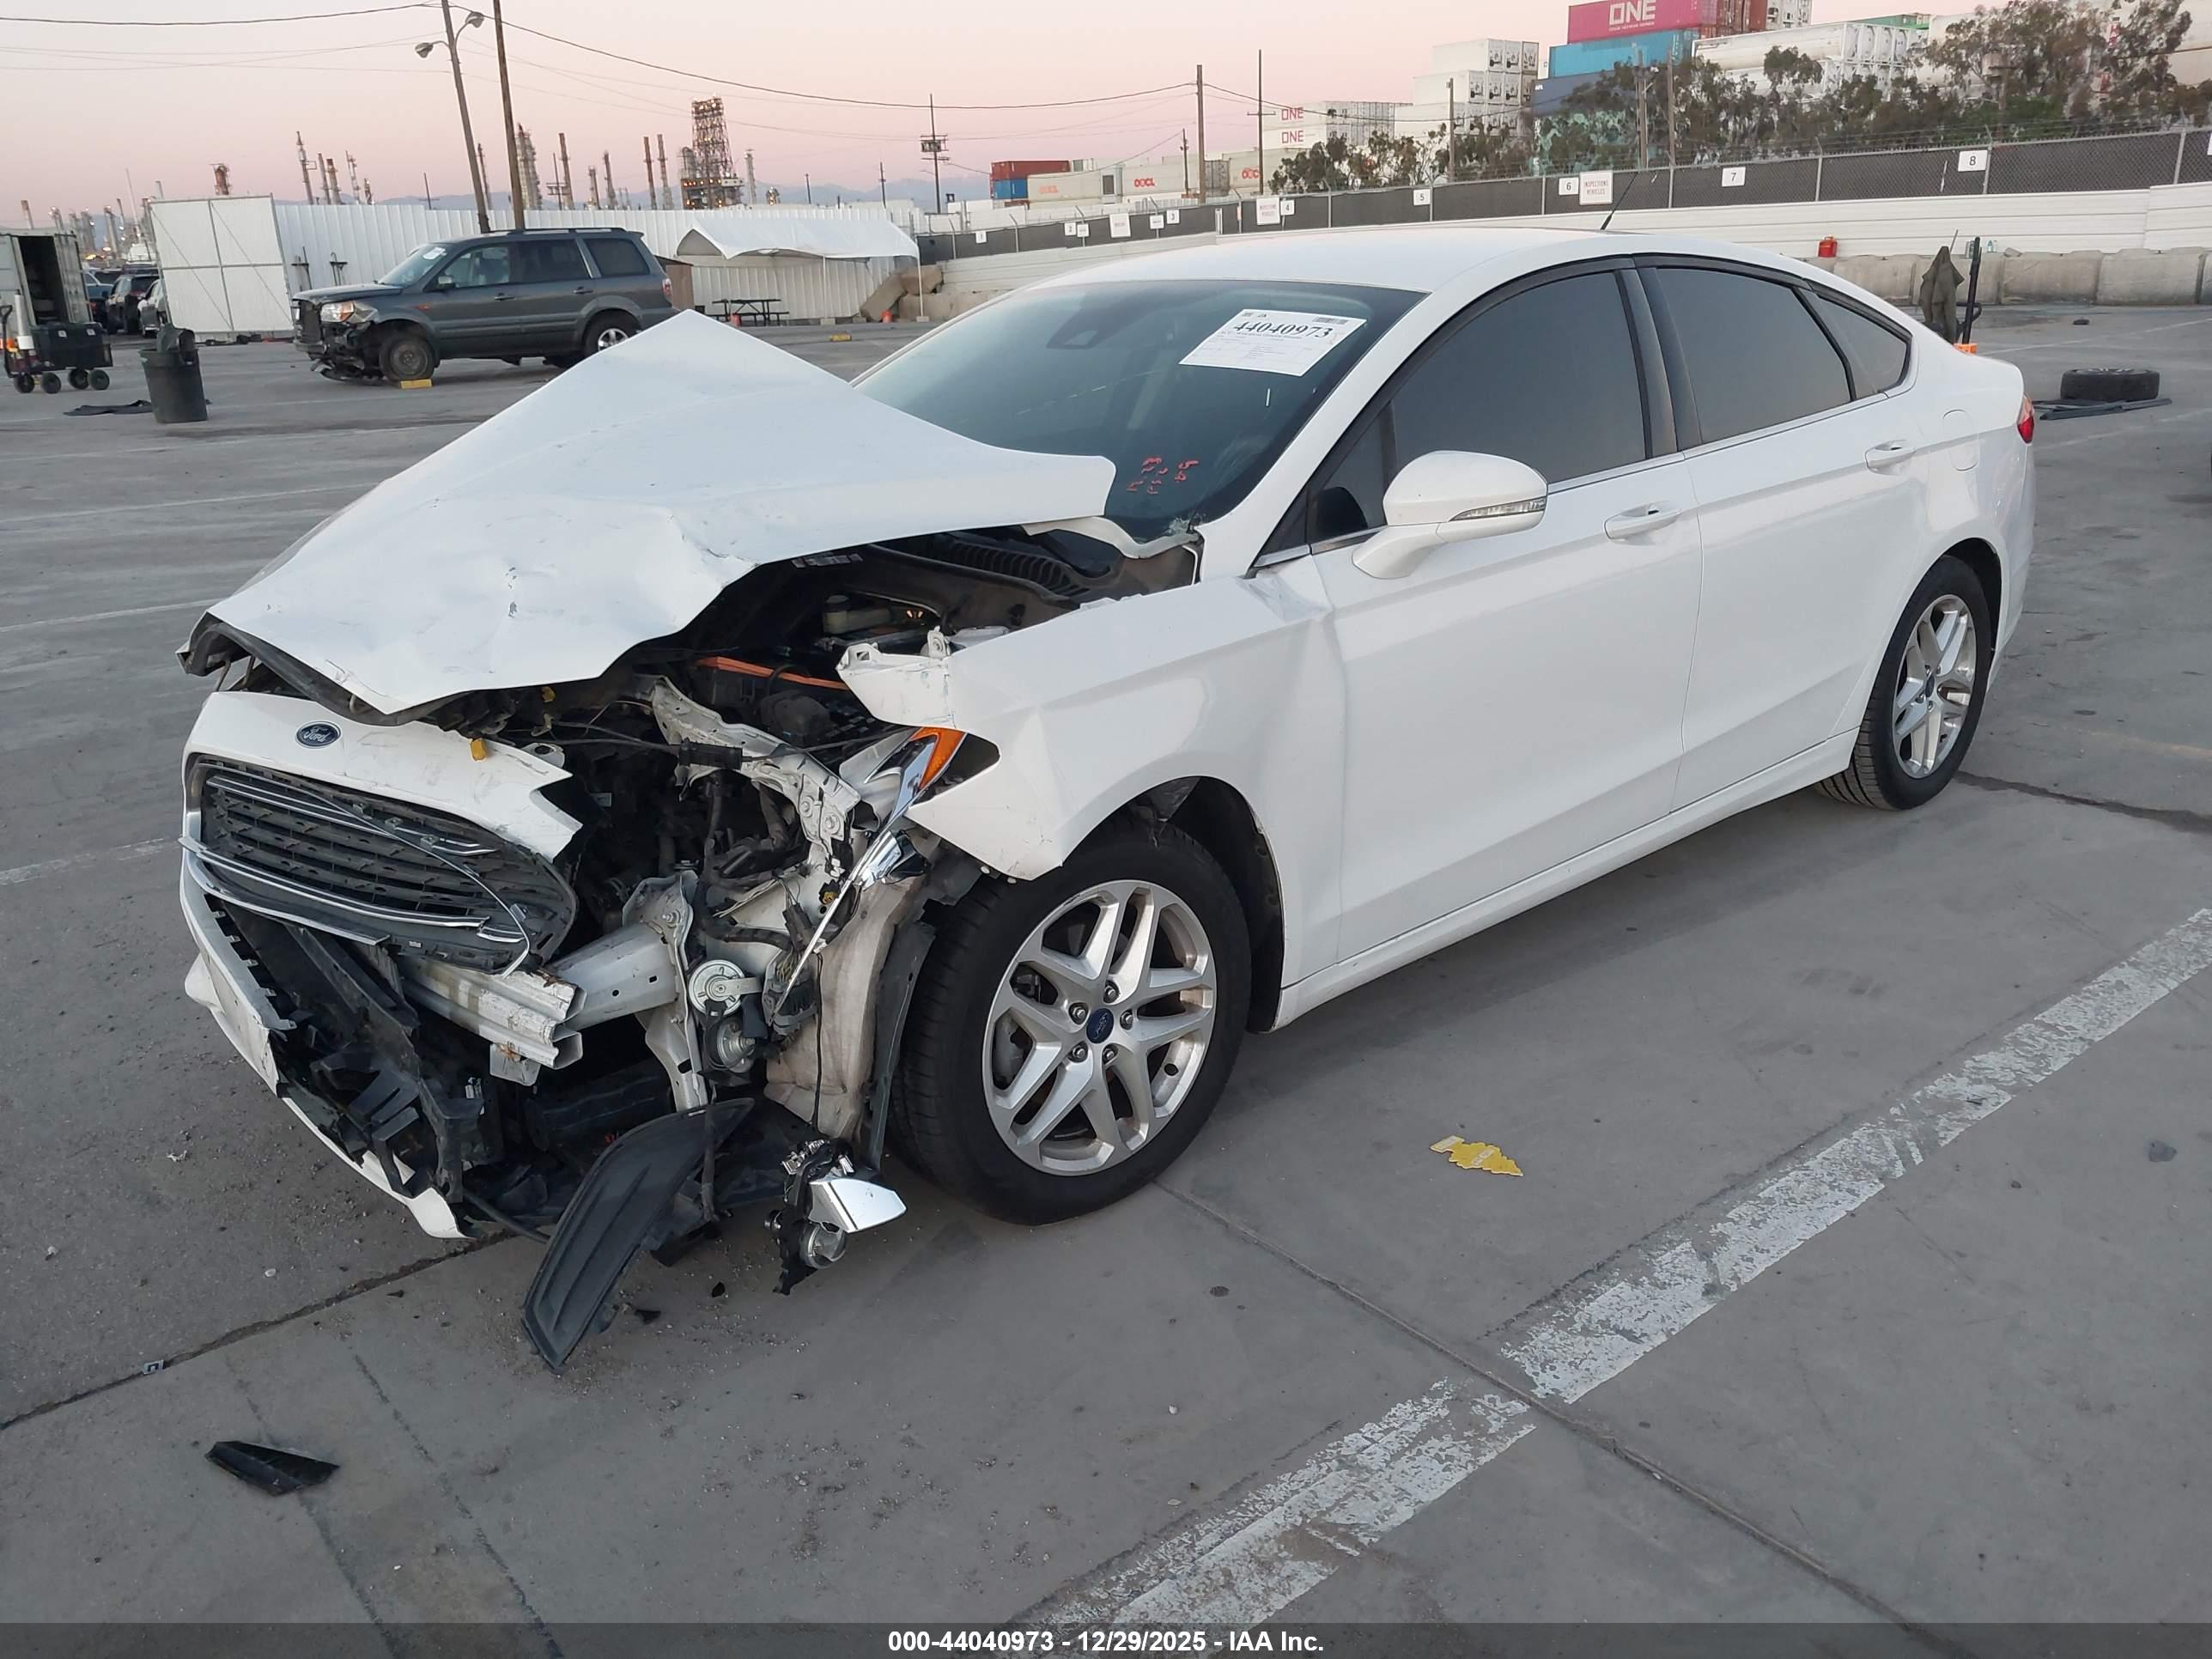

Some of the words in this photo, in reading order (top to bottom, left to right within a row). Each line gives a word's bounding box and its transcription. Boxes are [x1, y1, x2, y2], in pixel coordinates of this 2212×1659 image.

[1608, 0, 1656, 26] ONE
[1281, 107, 1304, 121] ONE
[1281, 131, 1304, 143] ONE
[1969, 155, 1977, 166] 8
[1730, 172, 1737, 182] 7
[1565, 181, 1571, 191] 6
[1419, 193, 1425, 202] 5
[1233, 321, 1334, 338] 44040973
[303, 726, 331, 743] Ford
